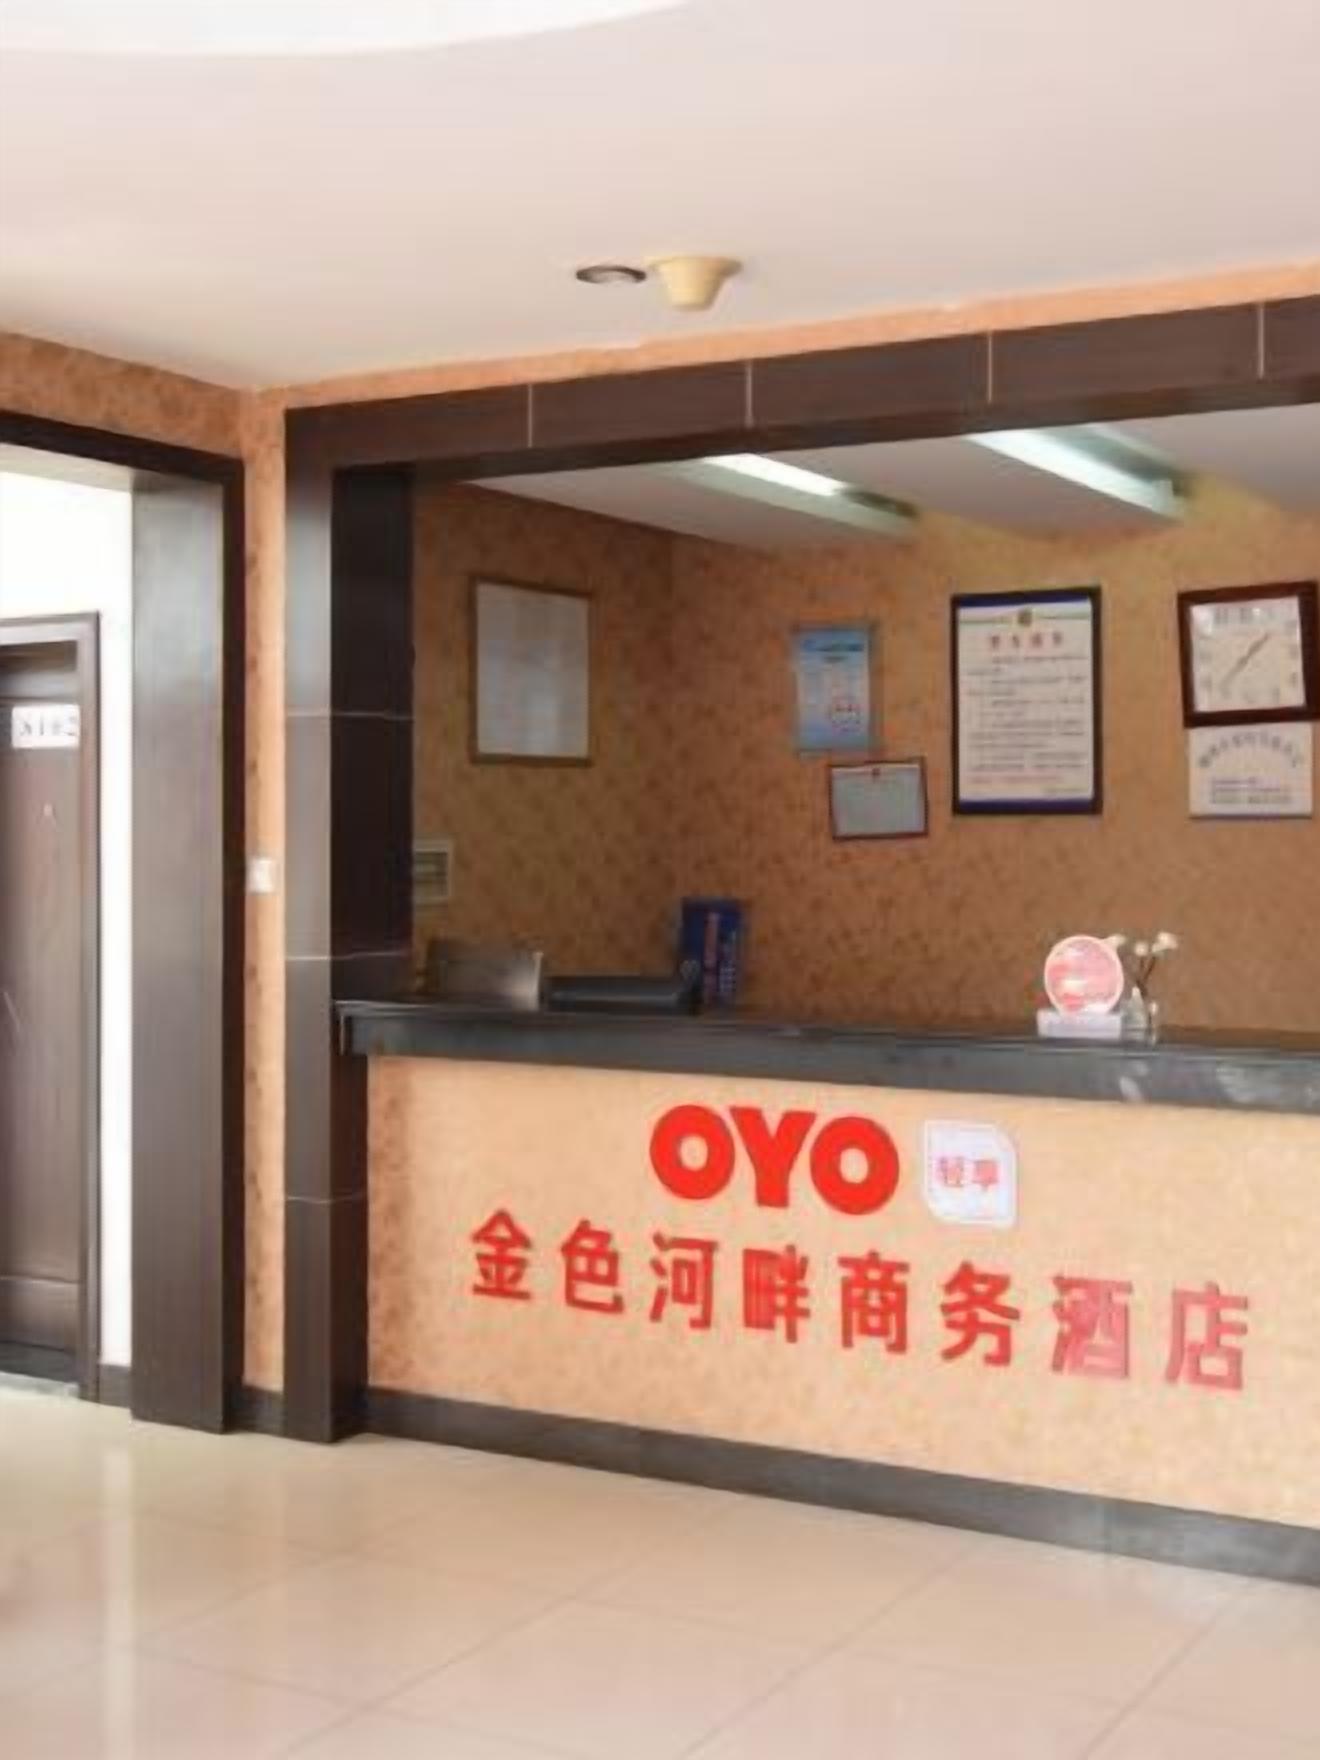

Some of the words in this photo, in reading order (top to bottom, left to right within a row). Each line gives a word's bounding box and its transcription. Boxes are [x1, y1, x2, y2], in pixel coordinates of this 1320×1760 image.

[649, 1104, 900, 1216] OYO
[470, 1208, 1250, 1391] 金色河畔商务酒店
